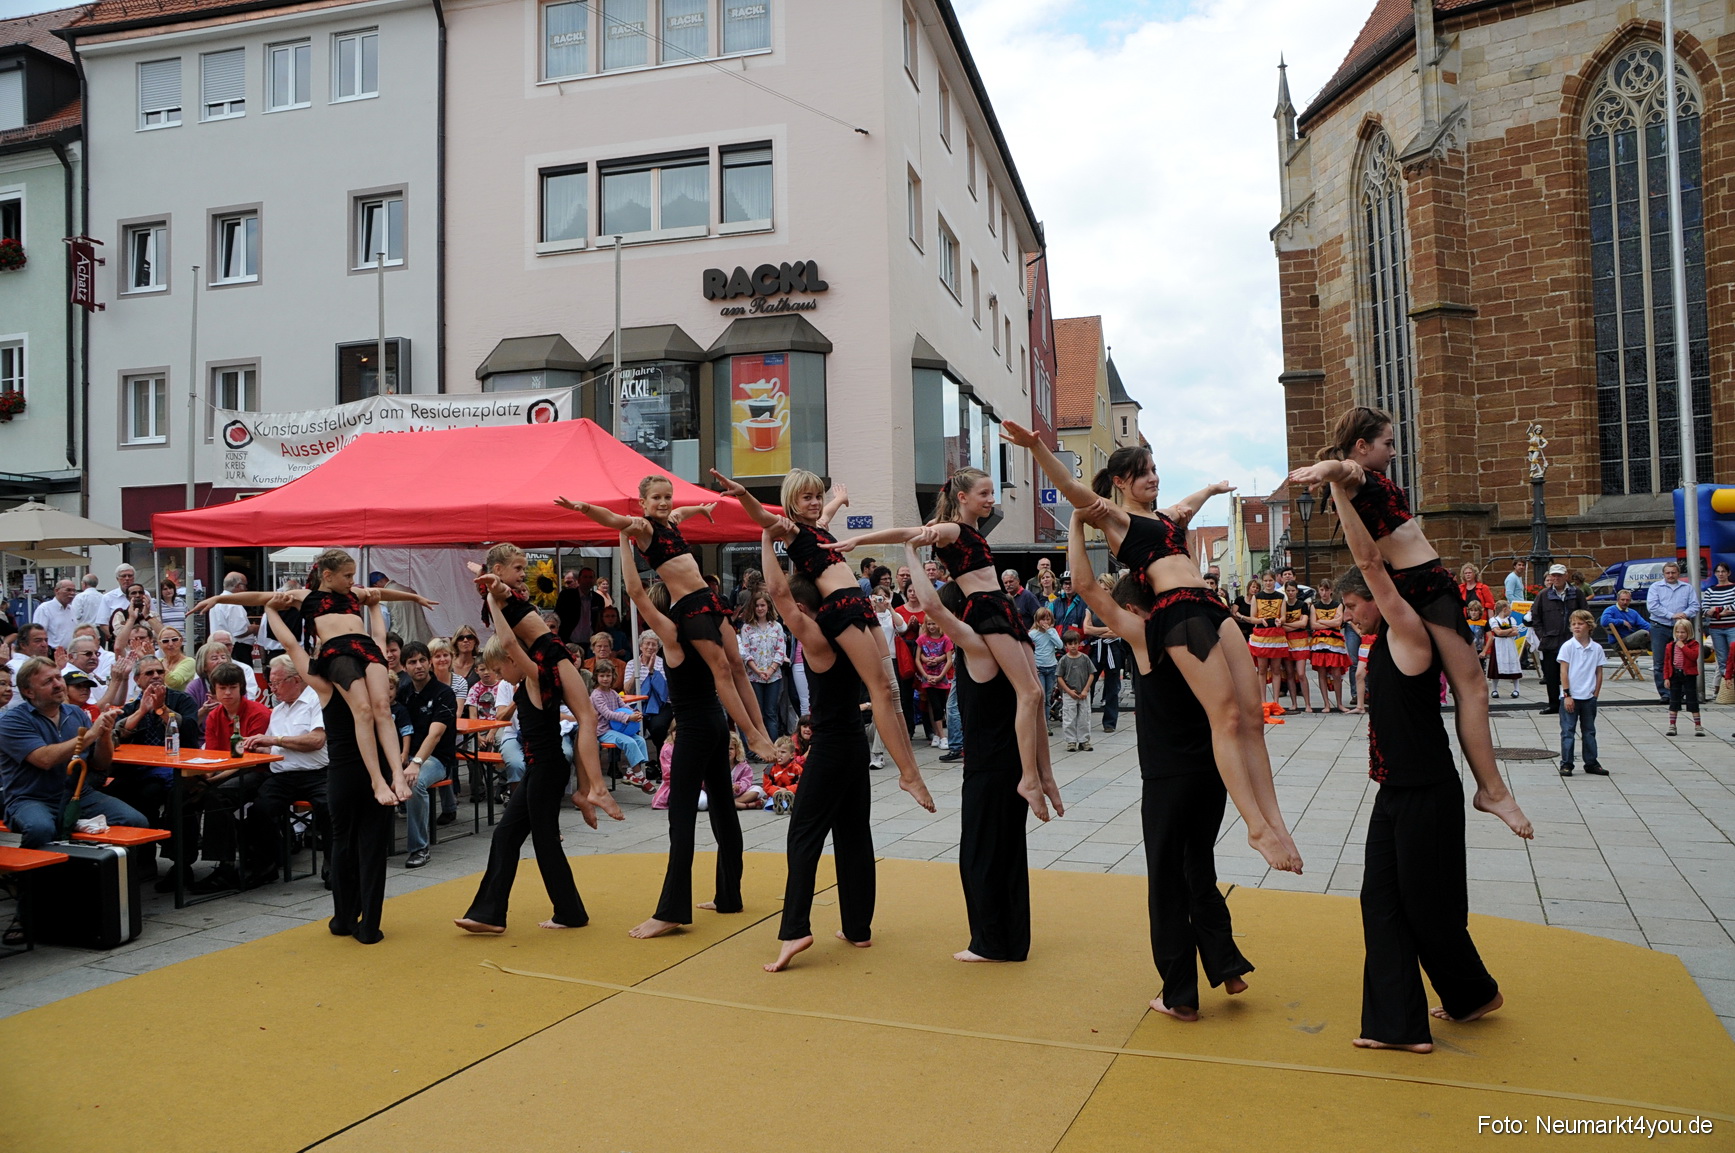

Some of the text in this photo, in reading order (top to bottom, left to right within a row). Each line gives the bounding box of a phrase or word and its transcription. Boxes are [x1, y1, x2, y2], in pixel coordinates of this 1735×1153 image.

[731, 4, 766, 18] RACKL
[670, 14, 704, 27] RACKL
[611, 22, 644, 36] RACKL
[553, 31, 585, 45] RACKL
[76, 251, 90, 301] Achatz
[702, 260, 829, 301] RACKL
[720, 297, 817, 316] am Rathaus
[632, 366, 656, 378] Jahre
[620, 379, 650, 399] ACKL
[379, 407, 404, 419] am
[411, 401, 521, 421] Residenzplatz
[281, 434, 359, 457] Ausstellun
[225, 452, 248, 460] KUNST
[225, 461, 246, 470] KREIS
[225, 471, 246, 480] JURA
